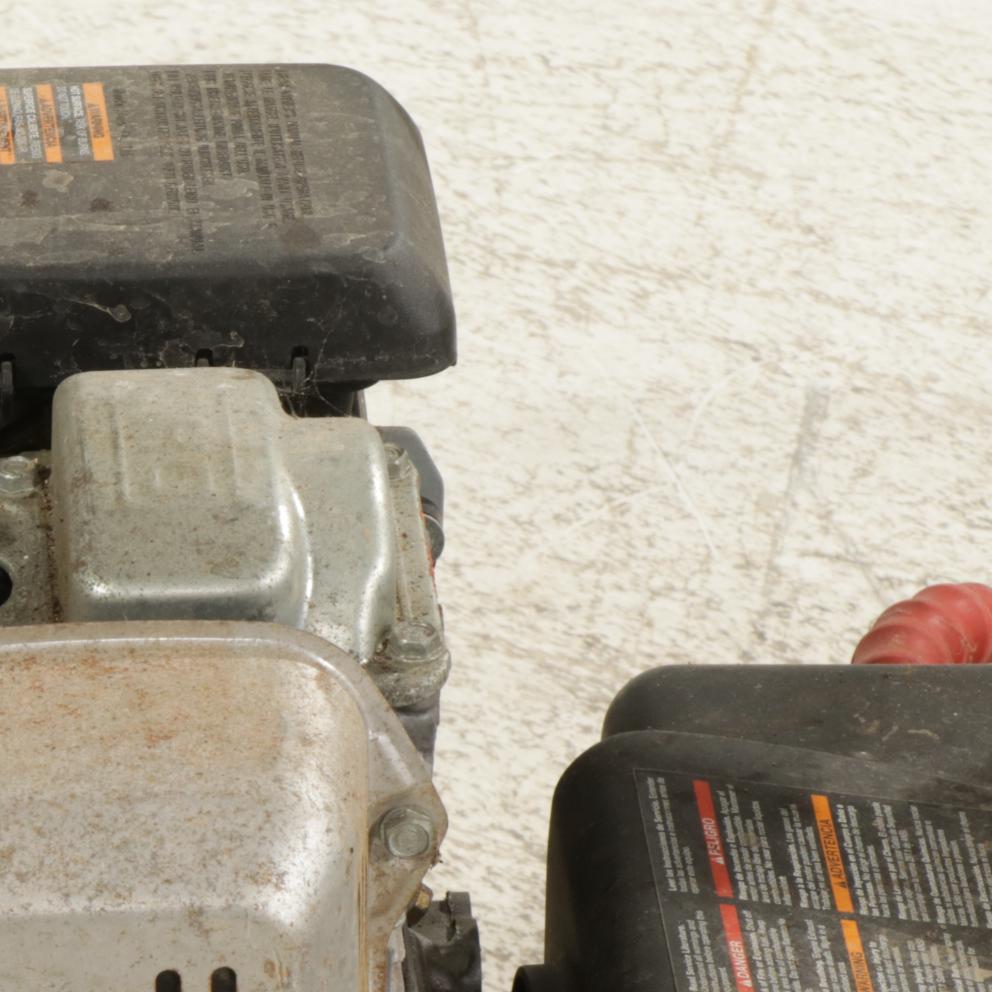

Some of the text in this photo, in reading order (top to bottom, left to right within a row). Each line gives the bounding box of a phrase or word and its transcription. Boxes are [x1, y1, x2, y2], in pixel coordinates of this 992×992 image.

[819, 819, 847, 880] ADVERTENCIA
[729, 940, 750, 980] DANGER
[853, 951, 874, 992] WARNING
